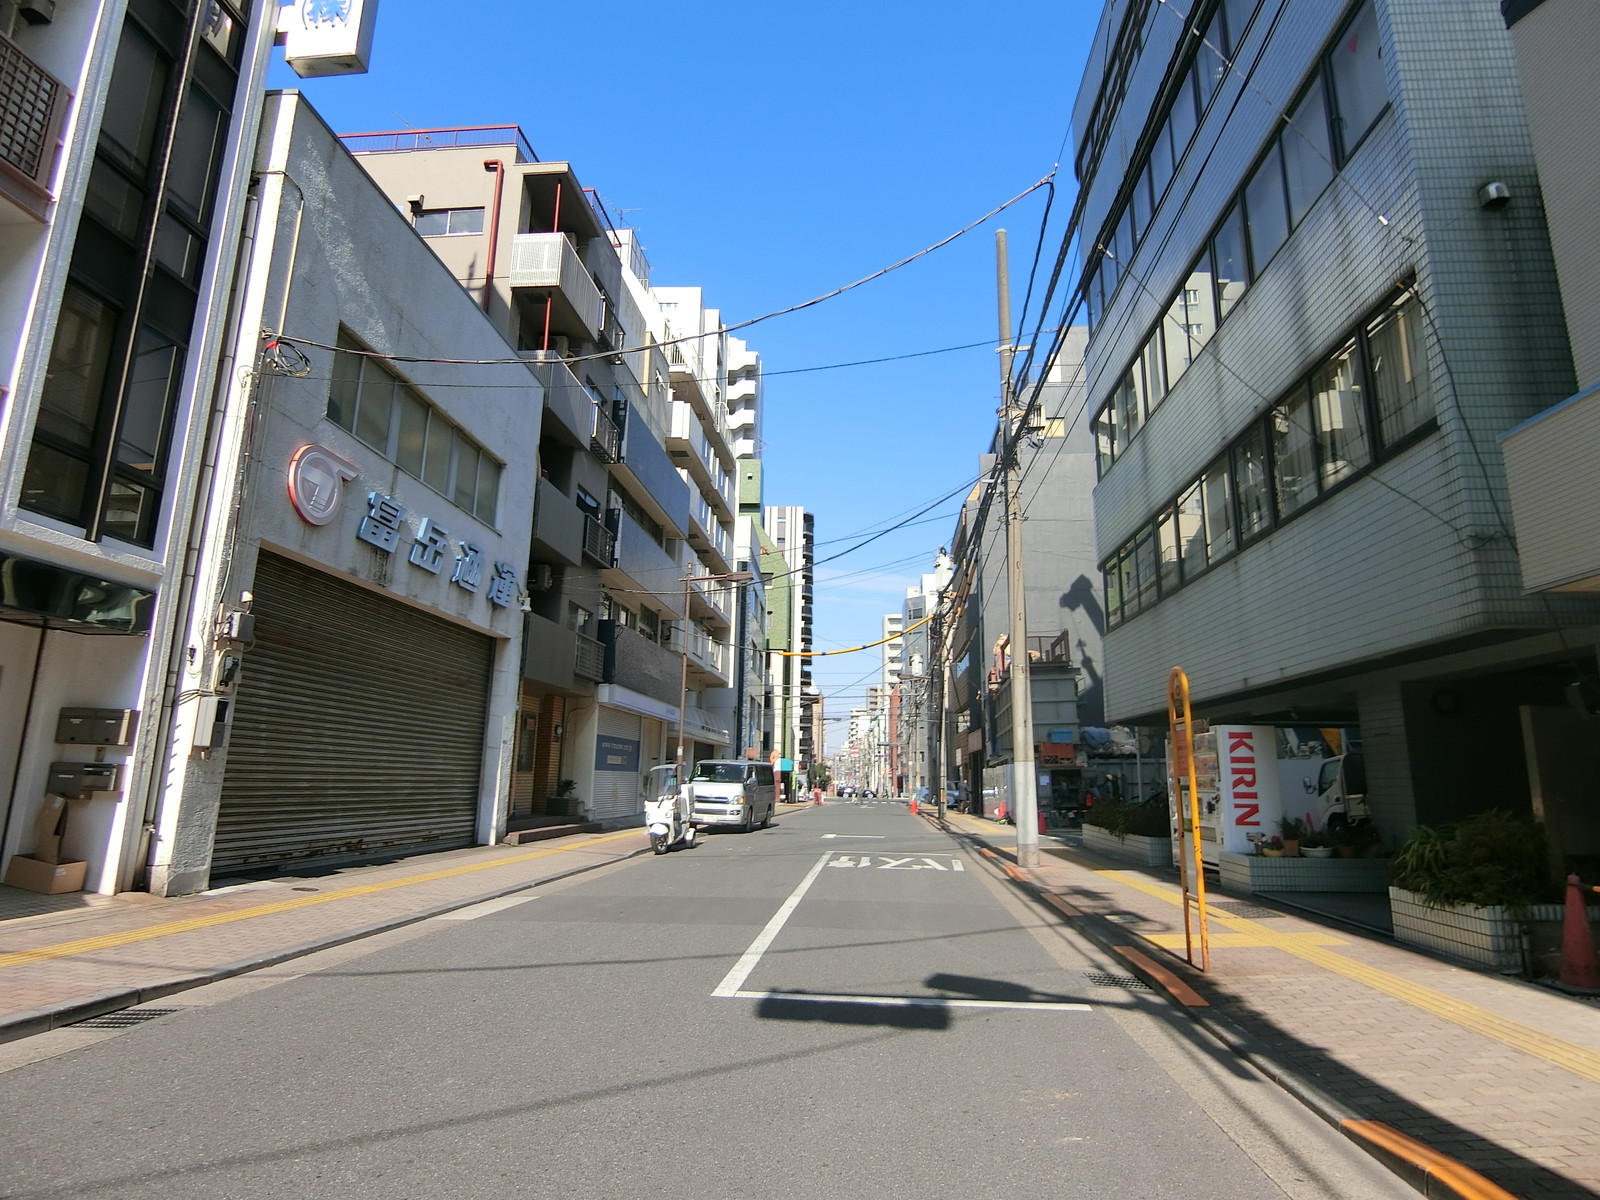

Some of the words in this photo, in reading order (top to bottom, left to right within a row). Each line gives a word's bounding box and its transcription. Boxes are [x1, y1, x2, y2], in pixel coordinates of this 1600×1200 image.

[1228, 731, 1261, 827] KIRIN
[826, 855, 965, 872] バス停
